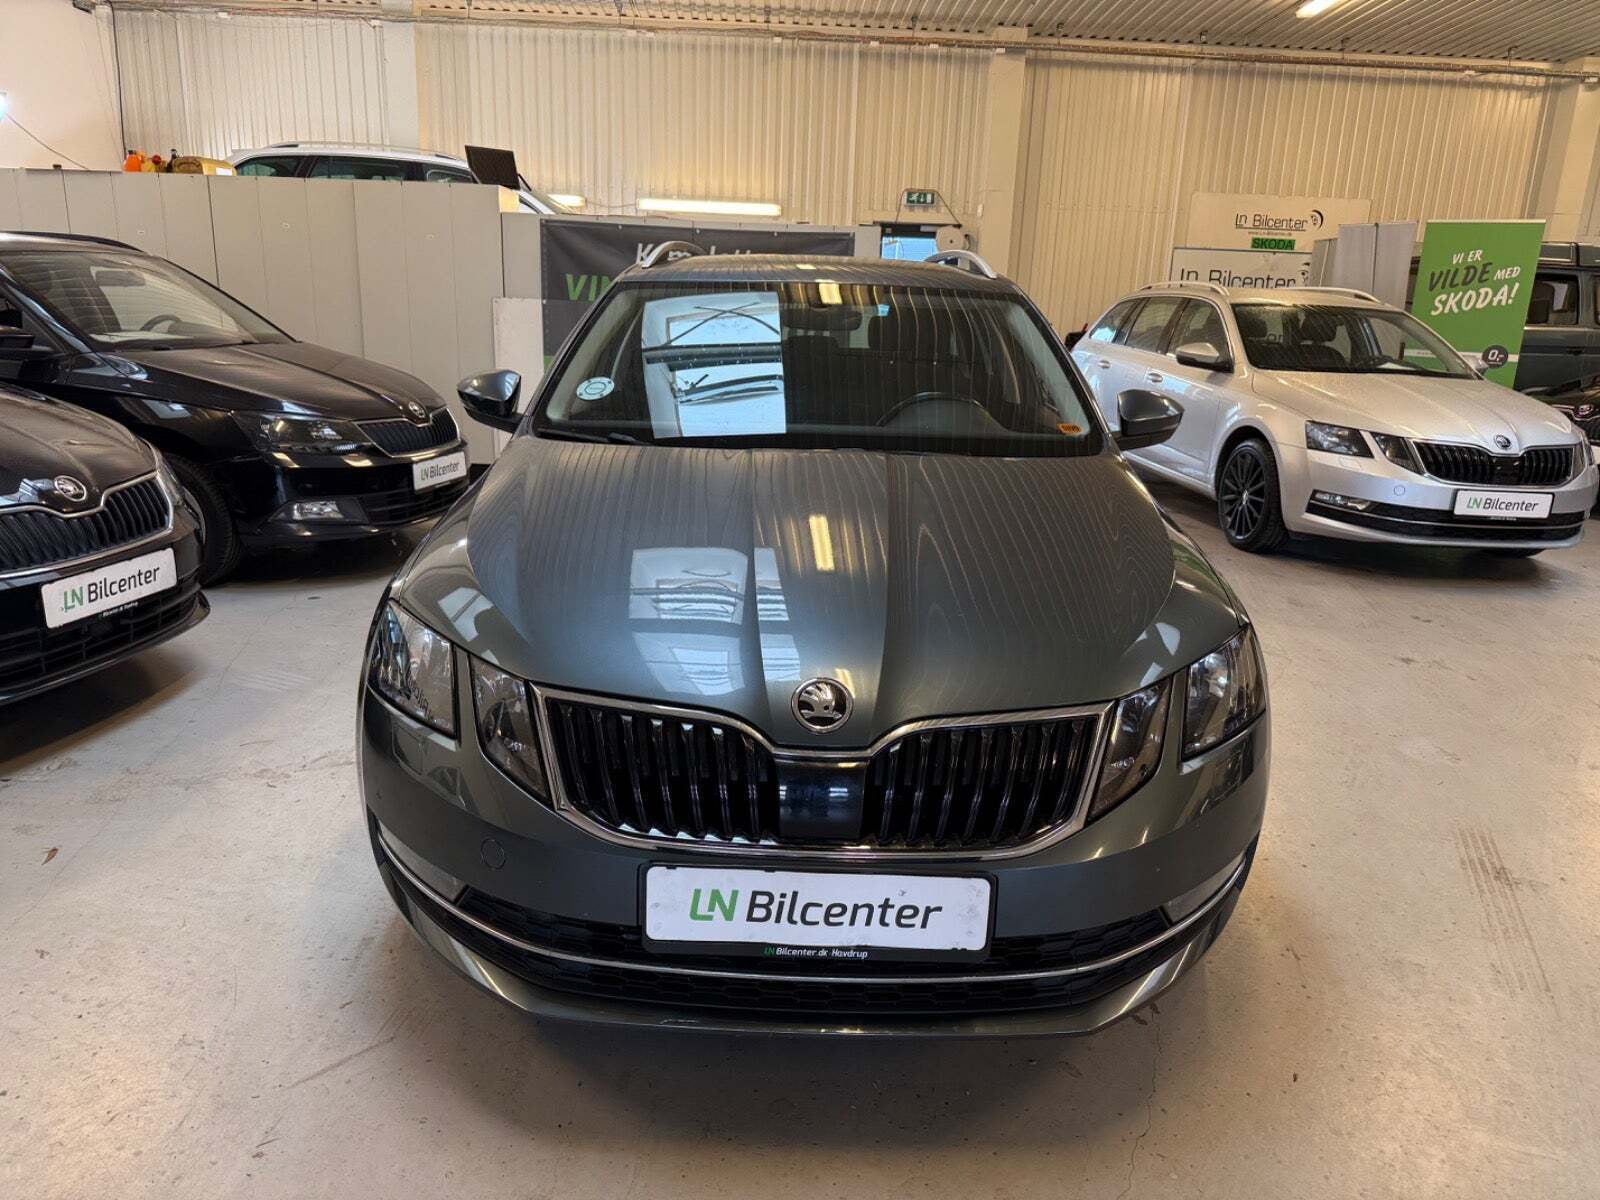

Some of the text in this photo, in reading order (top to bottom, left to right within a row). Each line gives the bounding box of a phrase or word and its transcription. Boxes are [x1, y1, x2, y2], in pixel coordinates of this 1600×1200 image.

[1252, 214, 1308, 229] Bilcenter
[1252, 238, 1295, 250] SKODA
[1452, 249, 1483, 265] VI ER
[1428, 262, 1521, 292] VILDE MED
[1430, 282, 1520, 316] SKODA!
[430, 461, 460, 479] Bilcenter
[1466, 497, 1539, 512] LN Bilcenter
[64, 586, 84, 613] LN
[87, 567, 160, 603] Bilcenter
[689, 887, 943, 930] LN Bilcenter
